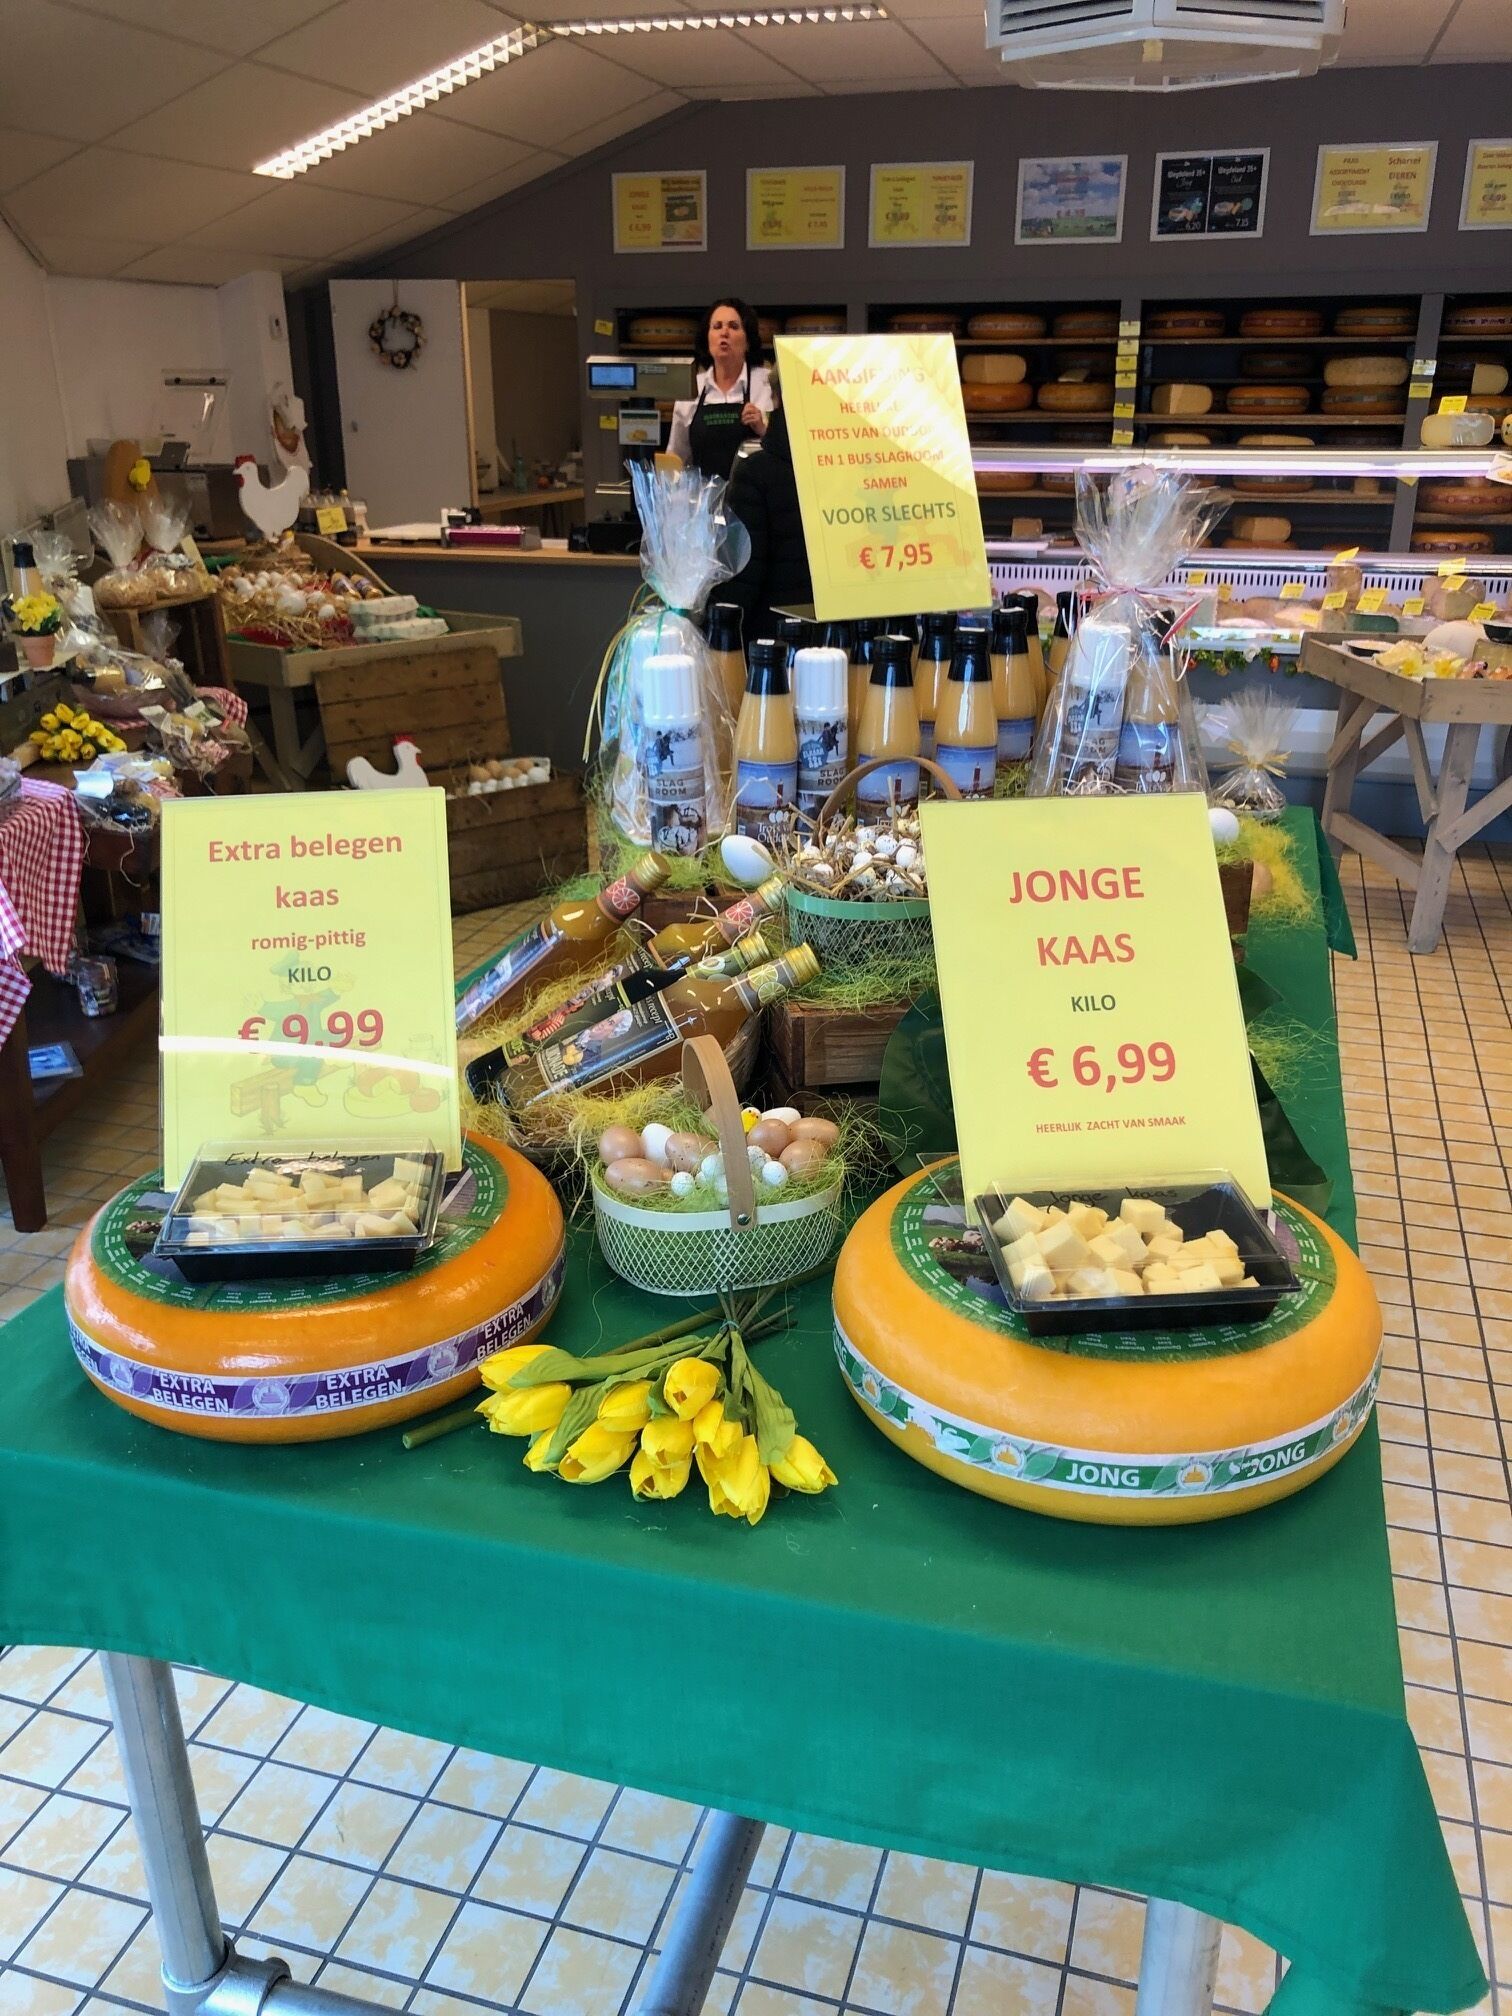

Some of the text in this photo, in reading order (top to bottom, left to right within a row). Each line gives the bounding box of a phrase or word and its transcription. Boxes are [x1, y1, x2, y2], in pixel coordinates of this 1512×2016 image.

[809, 427, 850, 441] TROTS
[851, 426, 879, 440] VAN
[816, 454, 834, 467] EN
[837, 454, 845, 466] 1
[847, 452, 872, 465] BUS
[863, 476, 908, 490] SAMEN
[822, 501, 956, 526] VOOR SLECHTS
[859, 542, 934, 572] € 7,95
[655, 787, 687, 796] ROOM
[656, 778, 684, 787] SLAG
[208, 833, 402, 863] Extra belegen
[275, 885, 340, 909] kaas
[1009, 867, 1145, 905] JONGE
[251, 929, 366, 951] romig-pittig
[1037, 933, 1136, 967] KAAS
[288, 966, 332, 983] KILO
[1071, 994, 1116, 1013] KILO
[238, 1016, 267, 1054] €
[1026, 1041, 1176, 1094] € 6,99
[1036, 1115, 1187, 1134] HEERLIJK ZACHT VAN SMAAK
[224, 1151, 283, 1166] Extra
[484, 1301, 524, 1340] EXTRA
[476, 1313, 532, 1361] BELEGEN
[159, 1372, 215, 1395] EXTRA
[325, 1364, 390, 1391] EXTRA
[152, 1387, 230, 1413] BELEGEN
[315, 1378, 403, 1410] BELEGEN
[1064, 1462, 1141, 1488] JONG
